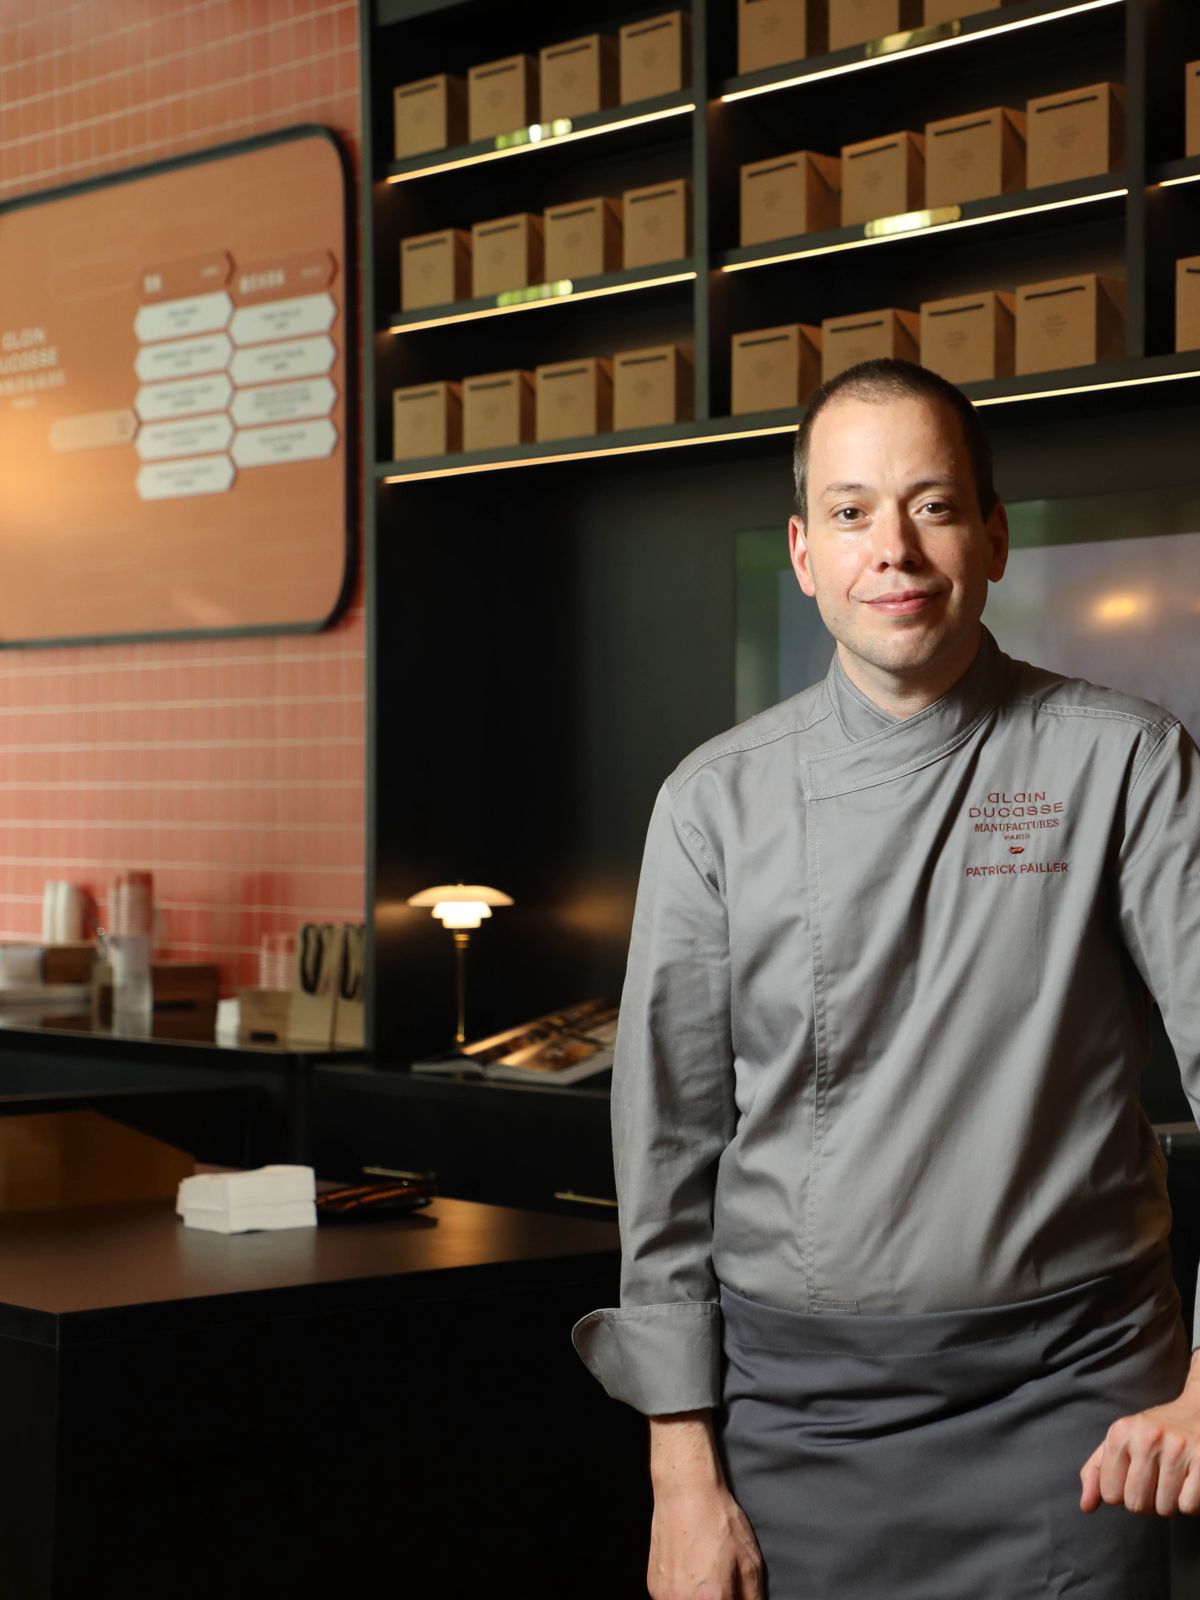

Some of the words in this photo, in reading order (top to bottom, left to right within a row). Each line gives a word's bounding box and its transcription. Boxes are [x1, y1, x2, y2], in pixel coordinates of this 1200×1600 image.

[975, 818, 1060, 833] MANUFACTURES
[1004, 833, 1031, 841] PARIS
[966, 864, 1017, 878] PATRICK
[1020, 862, 1069, 875] PAILLER
